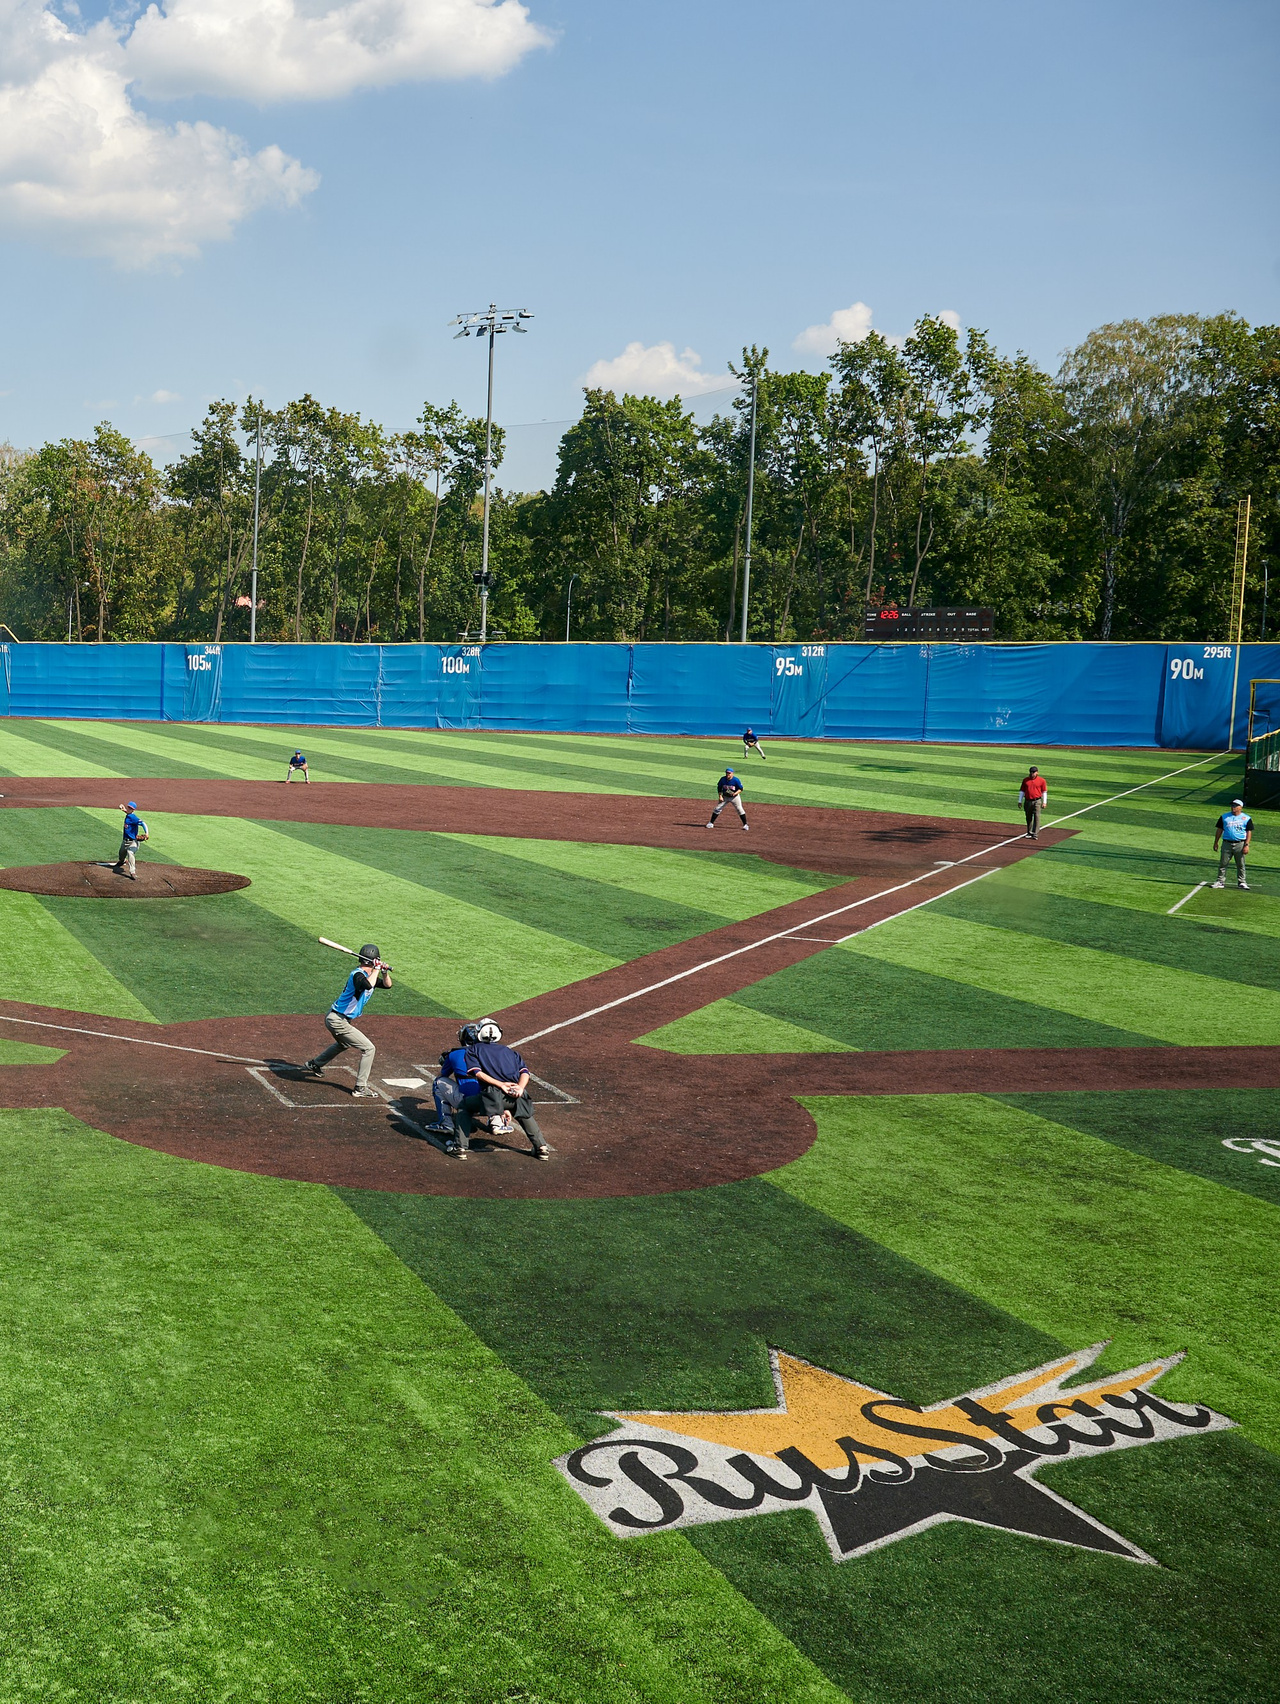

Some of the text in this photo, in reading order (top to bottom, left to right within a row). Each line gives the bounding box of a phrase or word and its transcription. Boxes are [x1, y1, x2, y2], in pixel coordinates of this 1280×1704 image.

[461, 646, 480, 656] 328ft
[801, 645, 825, 657] 312ft
[1203, 646, 1232, 658] 295ft
[187, 654, 212, 670] 105M
[441, 656, 470, 674] 100M
[775, 657, 803, 676] 95M
[1170, 658, 1204, 679] 90M
[566, 1385, 1213, 1529] RusStar
